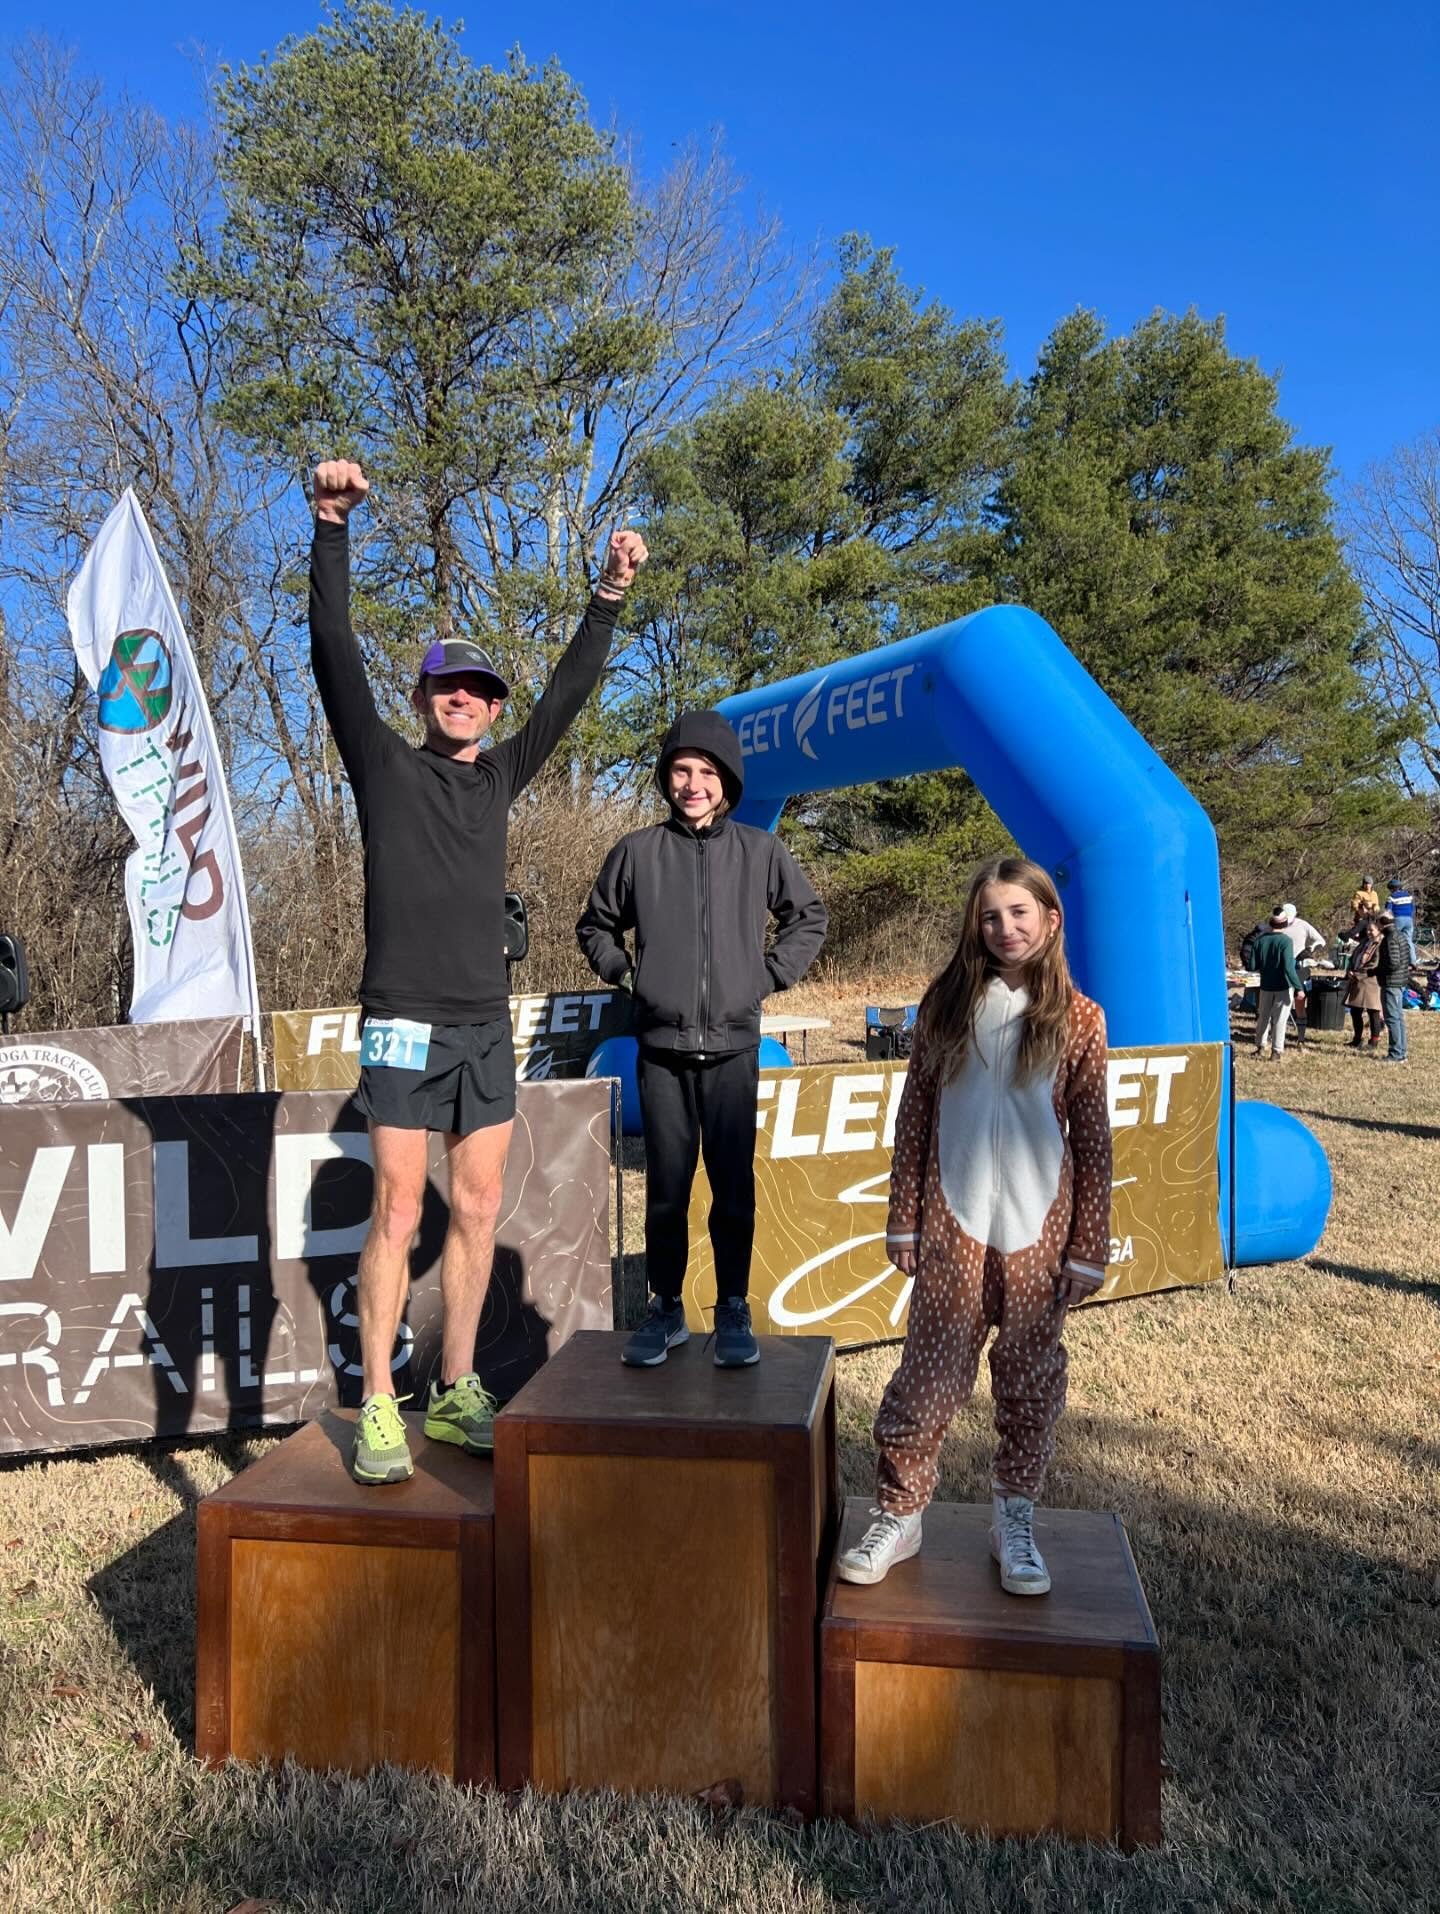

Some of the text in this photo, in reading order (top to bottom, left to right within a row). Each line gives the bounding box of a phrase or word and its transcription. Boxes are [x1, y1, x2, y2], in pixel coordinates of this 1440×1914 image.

[729, 664, 915, 756] EET FEET
[368, 1031, 414, 1064] 321
[32, 1050, 80, 1071] TRACK
[79, 1068, 103, 1099] CLU
